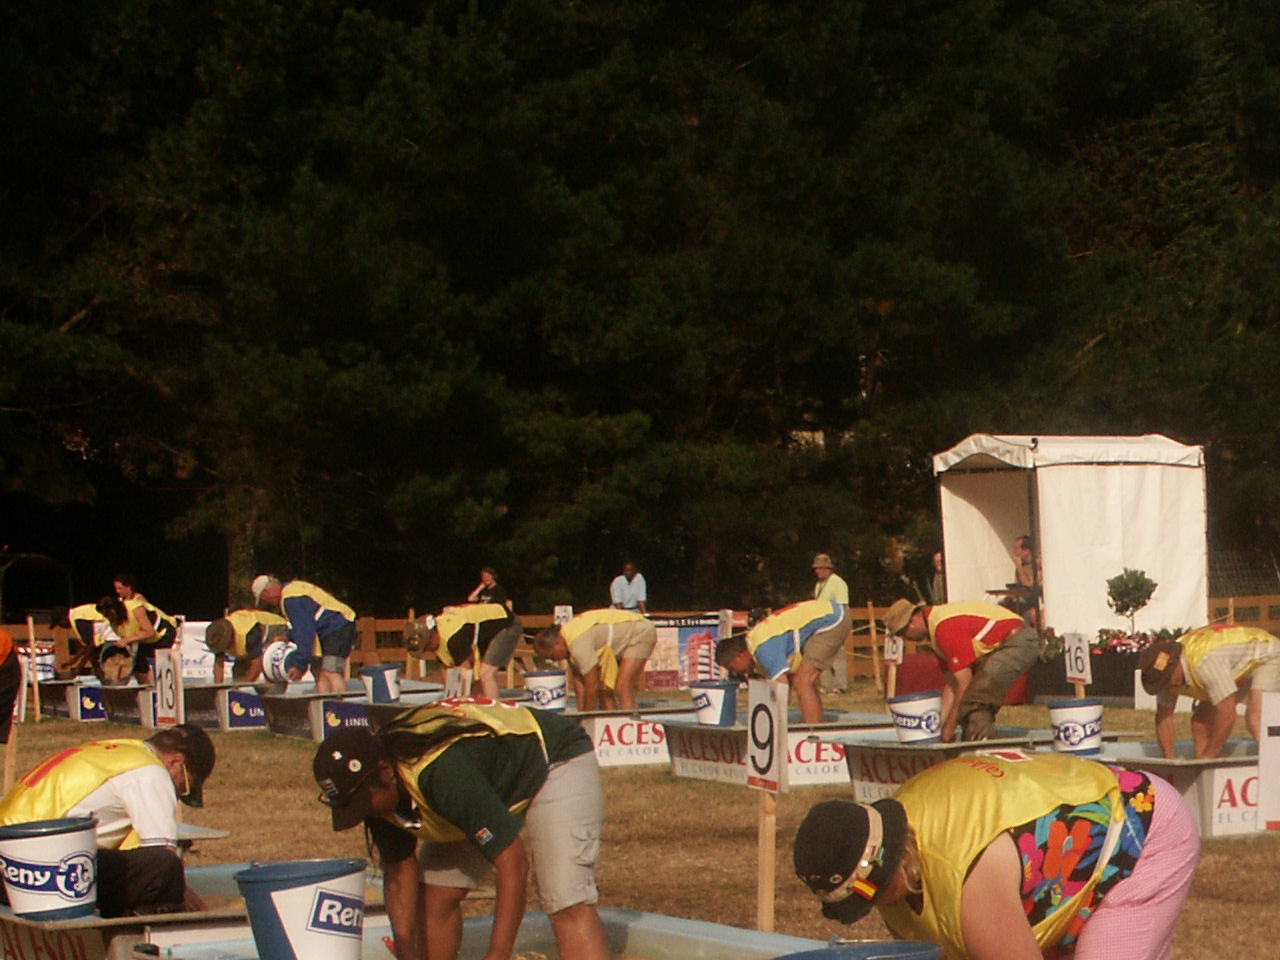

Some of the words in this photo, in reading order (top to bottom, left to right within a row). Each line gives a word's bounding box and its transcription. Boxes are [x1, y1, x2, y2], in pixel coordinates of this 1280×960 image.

[1065, 646, 1085, 674] 16
[158, 668, 175, 710] 13
[599, 722, 665, 747] ACES
[893, 713, 920, 728] eny
[679, 731, 747, 766] ACESOL
[750, 703, 774, 776] 9
[788, 739, 846, 763] CES
